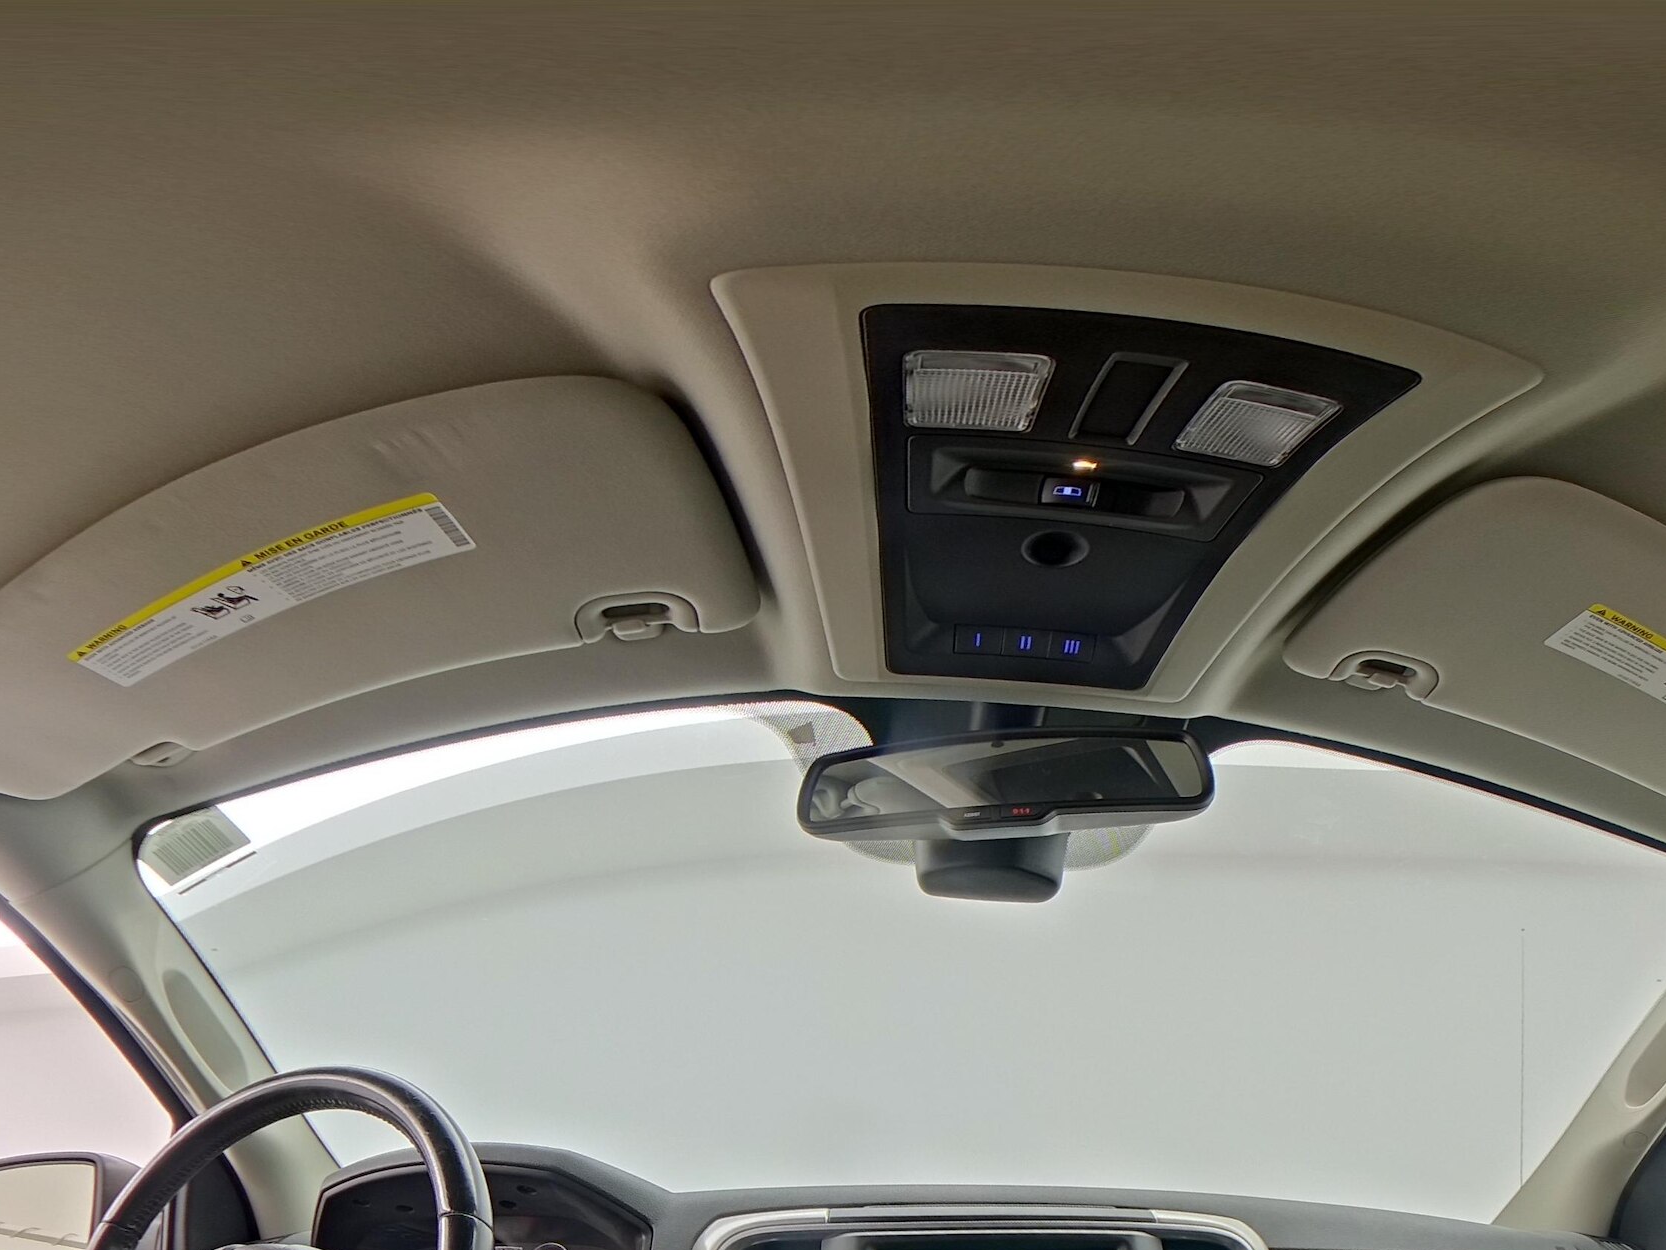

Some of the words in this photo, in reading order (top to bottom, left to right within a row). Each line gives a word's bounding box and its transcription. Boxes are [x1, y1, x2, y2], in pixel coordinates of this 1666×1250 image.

[254, 545, 282, 560] MISE
[285, 536, 303, 547] EN
[304, 521, 350, 540] GARDE
[85, 624, 127, 649] WARNING
[1611, 614, 1654, 639] WARNING
